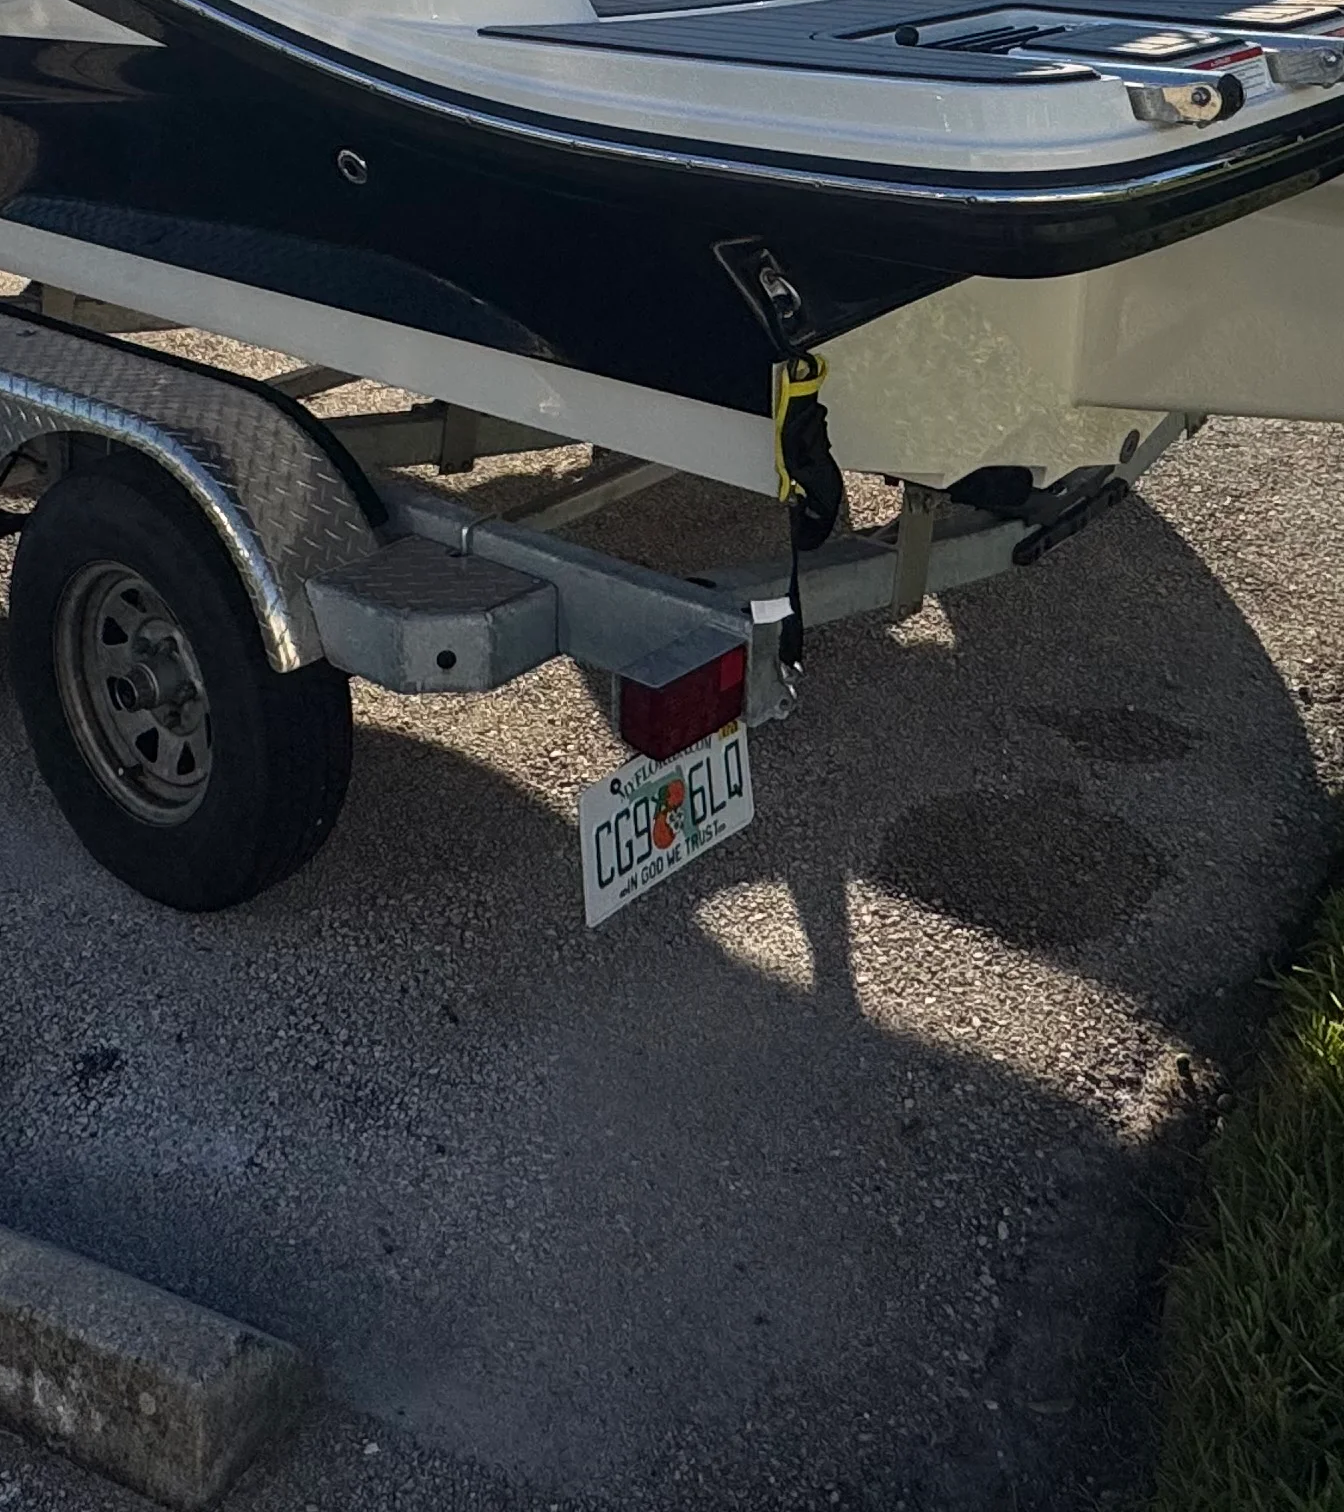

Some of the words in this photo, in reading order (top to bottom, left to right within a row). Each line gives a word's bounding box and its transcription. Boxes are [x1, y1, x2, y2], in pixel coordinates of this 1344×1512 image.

[594, 795, 653, 889] CG9
[687, 739, 744, 826] 6LQ
[627, 874, 639, 892] IN
[641, 859, 664, 885] GOD
[666, 844, 682, 867] WE
[685, 819, 720, 857] TRUST
